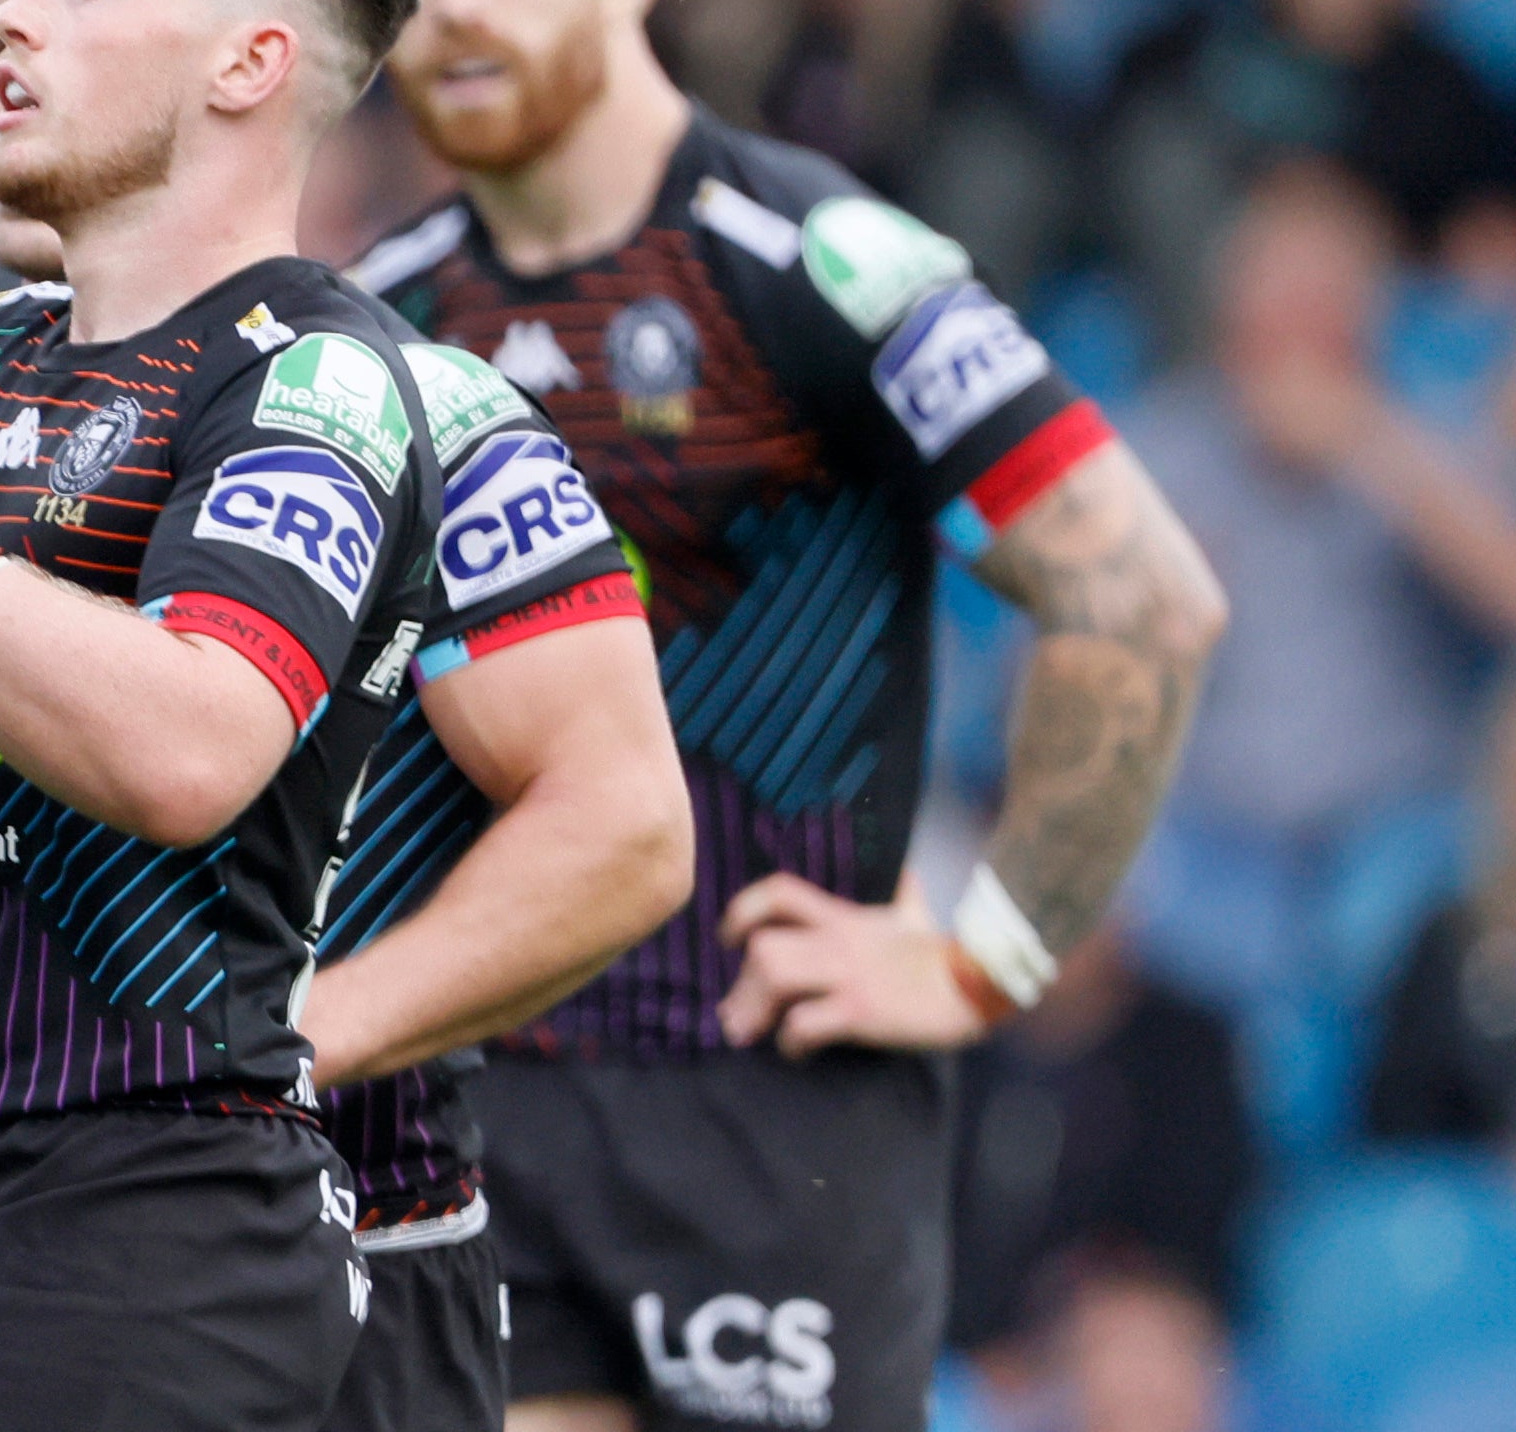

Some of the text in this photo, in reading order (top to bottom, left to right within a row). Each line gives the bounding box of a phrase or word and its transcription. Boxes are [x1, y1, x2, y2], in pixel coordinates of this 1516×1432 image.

[262, 408, 326, 434] BOILERS
[333, 428, 355, 447] EV
[264, 378, 404, 470] heatable
[33, 493, 89, 529] 1134
[207, 483, 370, 597] CRS
[440, 472, 596, 582] CRS
[630, 1290, 837, 1403] LCS
